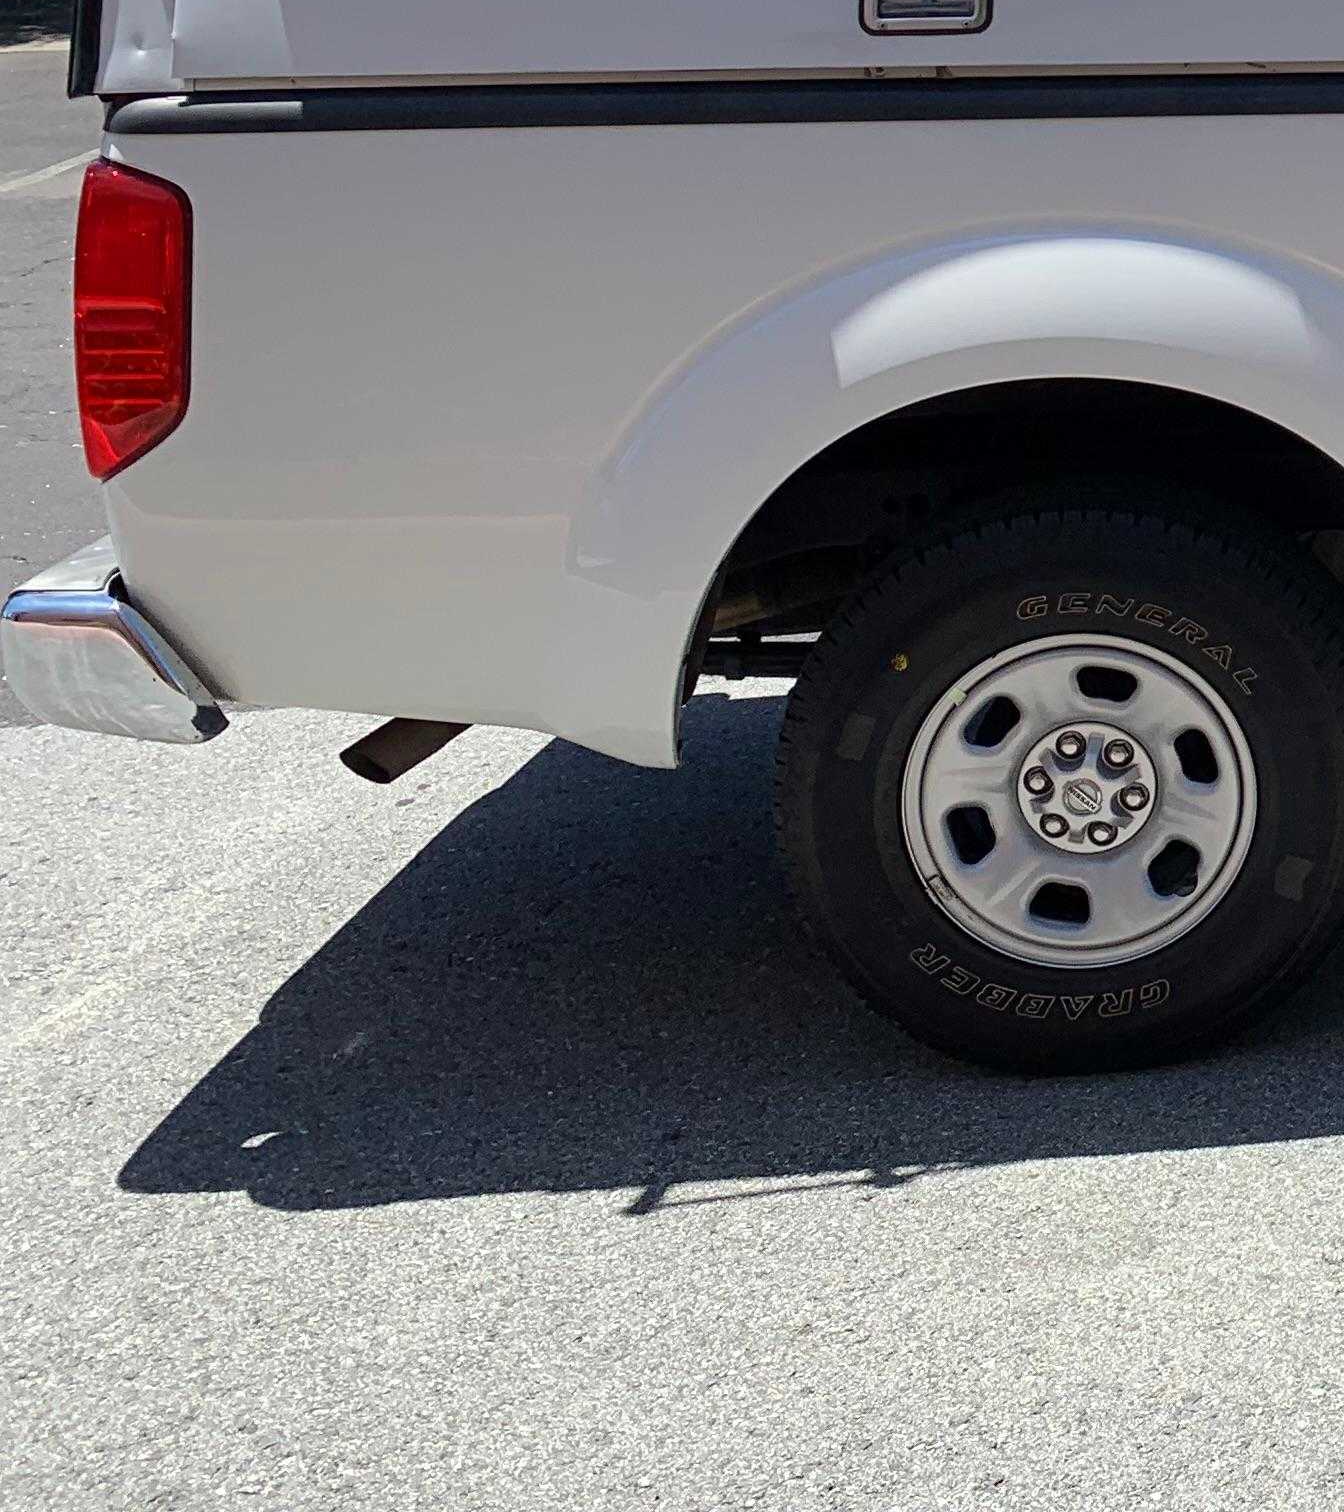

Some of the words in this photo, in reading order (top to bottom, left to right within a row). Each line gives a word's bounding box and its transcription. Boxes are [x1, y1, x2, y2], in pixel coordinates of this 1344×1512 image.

[1016, 592, 1259, 695] GENERAL
[1068, 787, 1097, 811] NISSAN
[910, 943, 1171, 1021] GRABBER
